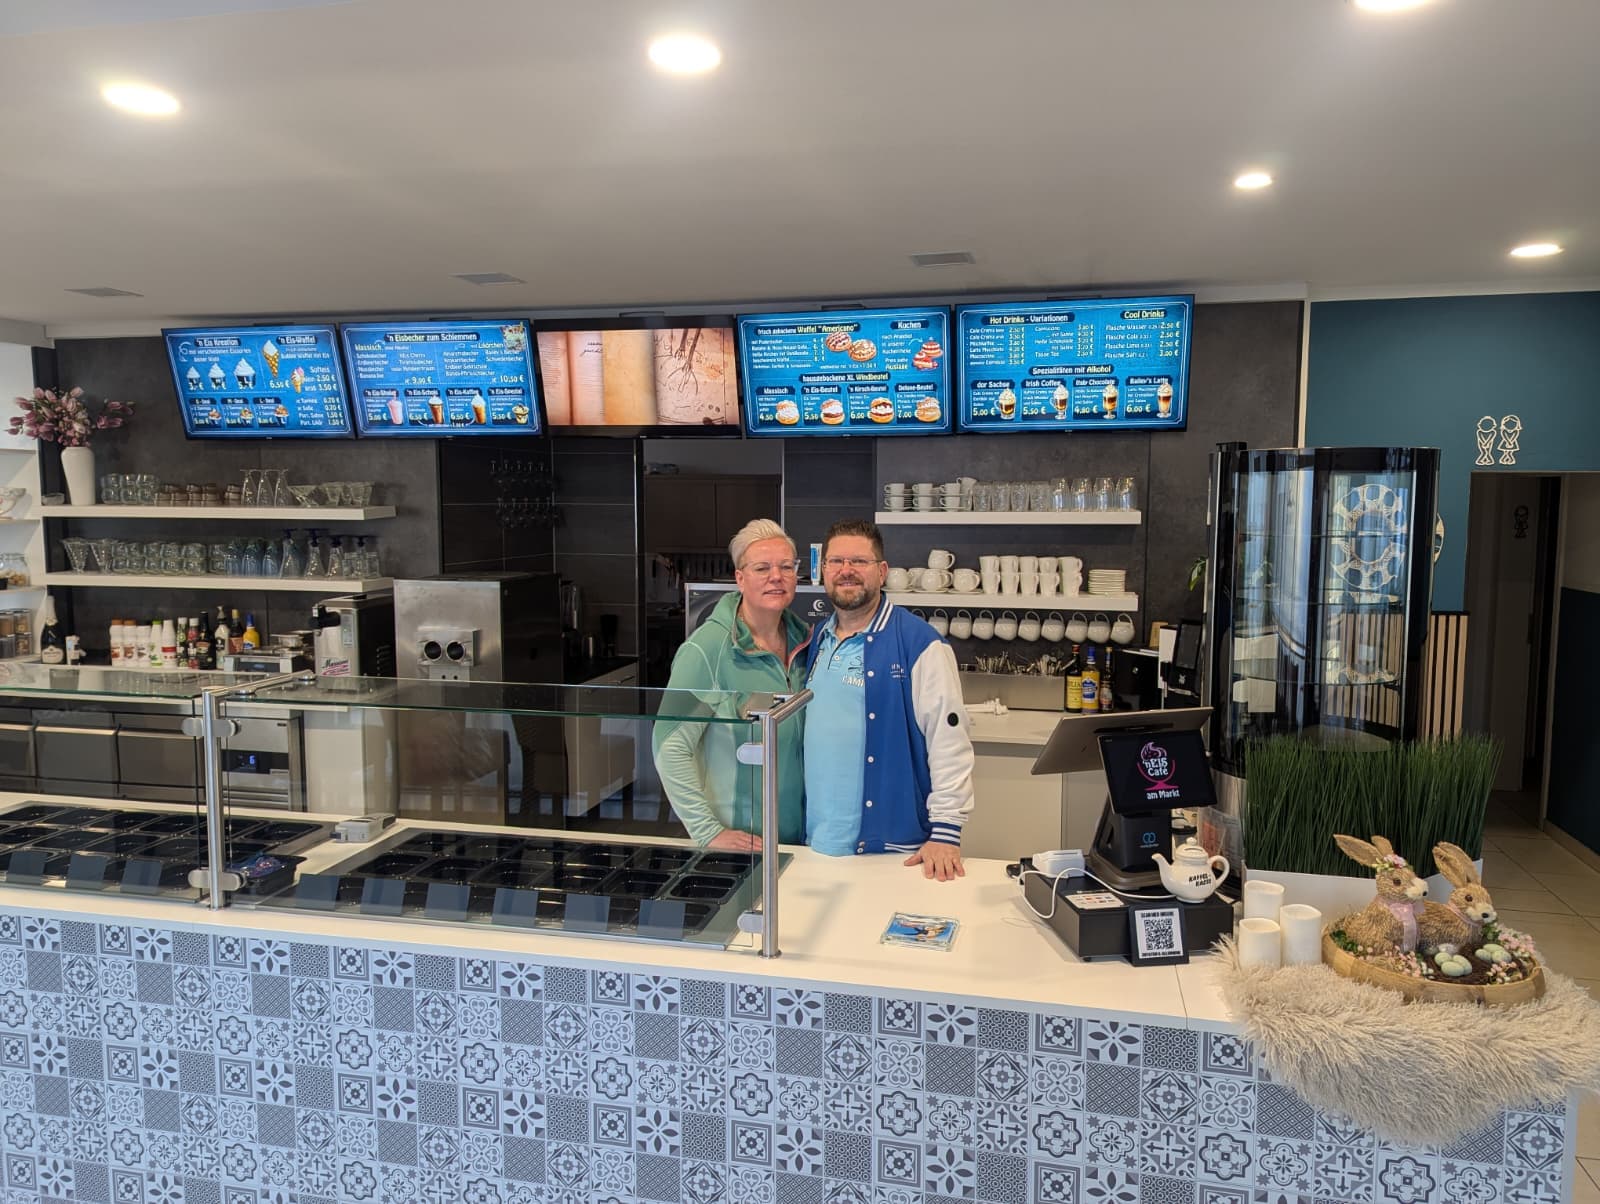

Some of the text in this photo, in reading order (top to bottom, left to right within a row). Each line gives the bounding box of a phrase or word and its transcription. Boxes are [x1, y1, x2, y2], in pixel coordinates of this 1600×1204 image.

[989, 316, 1002, 324] Hot
[1003, 315, 1025, 323] Drinks
[1030, 314, 1069, 322] Variationen
[1124, 310, 1165, 319] Cool Drinks
[797, 325, 817, 333] Waffel
[897, 321, 922, 329] Kuchen
[1160, 321, 1174, 329] 2.50
[1175, 321, 1181, 329] €
[394, 334, 425, 342] Eisbecher
[1160, 331, 1174, 339] 2.50
[1175, 330, 1181, 338] €
[1174, 340, 1180, 348] €
[1174, 349, 1180, 357] €
[1032, 365, 1111, 376] Spezialitäten mit Alkohol
[856, 373, 889, 381] Windbeutel
[972, 407, 996, 416] 5.00 €
[1023, 406, 1046, 415] 5.50 €
[1092, 405, 1098, 414] €
[1145, 404, 1151, 413] €
[1146, 789, 1180, 800] am Markt
